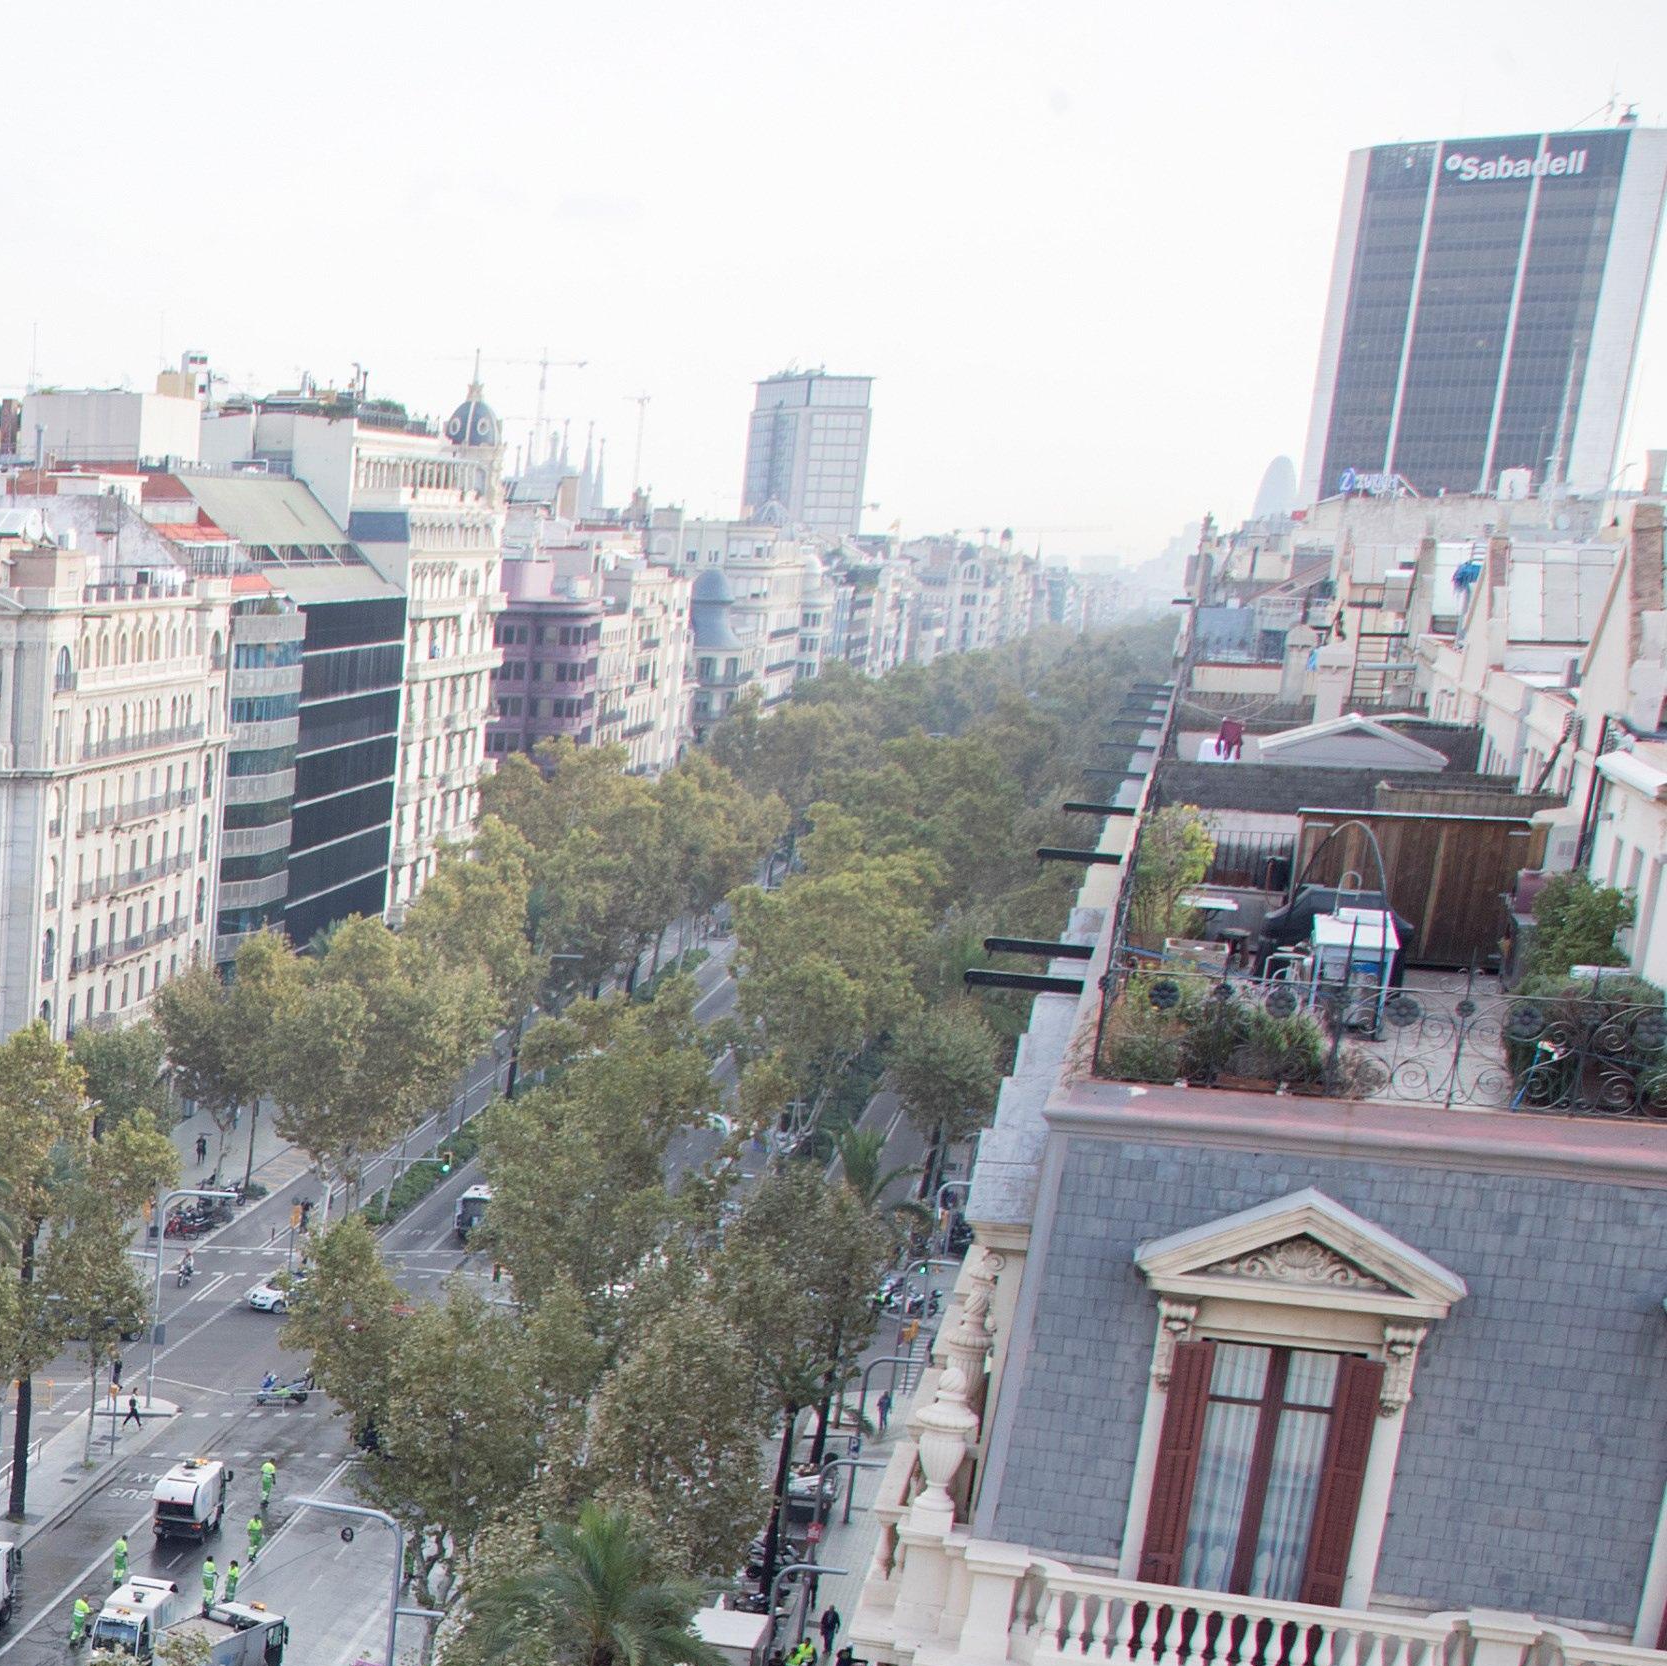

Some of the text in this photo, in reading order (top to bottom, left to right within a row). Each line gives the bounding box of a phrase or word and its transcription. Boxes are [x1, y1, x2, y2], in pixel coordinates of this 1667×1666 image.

[1457, 149, 1588, 182] Sabadell
[122, 1471, 164, 1484] AXI
[107, 1487, 153, 1501] BUS
